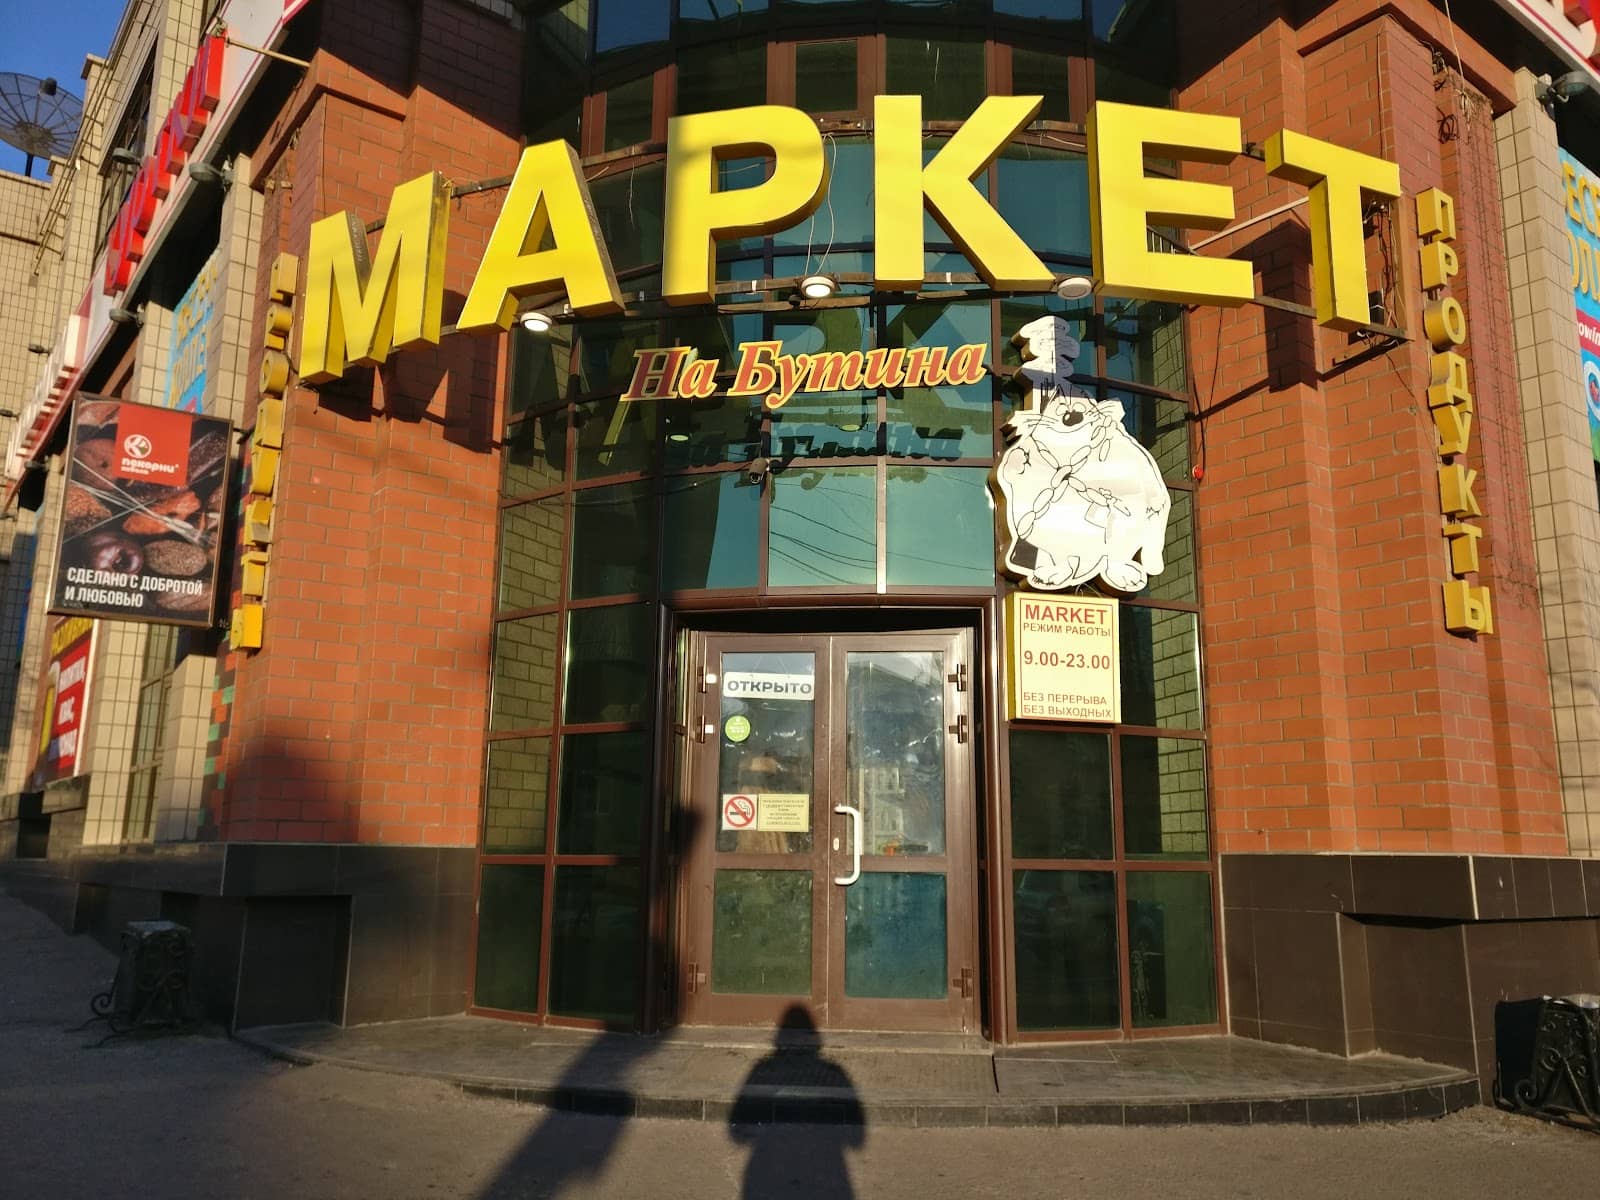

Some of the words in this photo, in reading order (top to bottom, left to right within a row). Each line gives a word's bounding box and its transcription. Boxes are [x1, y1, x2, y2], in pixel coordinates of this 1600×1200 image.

[299, 94, 1401, 383] МАРКЕТ
[620, 346, 718, 401] На
[727, 340, 987, 409] Бутина
[1416, 186, 1493, 634] ПРОДУКТЫ
[67, 567, 128, 588] СДЕЛАНО
[129, 575, 139, 589] С
[140, 575, 203, 595] ДОБРОТОЙ
[64, 586, 75, 601] И
[76, 587, 143, 608] ЛЮБОВЬЮ
[1025, 604, 1108, 625] MARKET
[1023, 622, 1062, 634] РЕЖИМ
[1065, 625, 1111, 637] РАБОТЫ
[1024, 650, 1110, 670] 9.00-23.00
[727, 680, 812, 694] ОТКРЫТО
[1023, 691, 1045, 702] БЕЗ
[1047, 693, 1107, 705] ПЕРЕРЫВА
[1023, 704, 1045, 715] БЕЗ
[1048, 706, 1112, 718] ВЫХОДНЫХ
